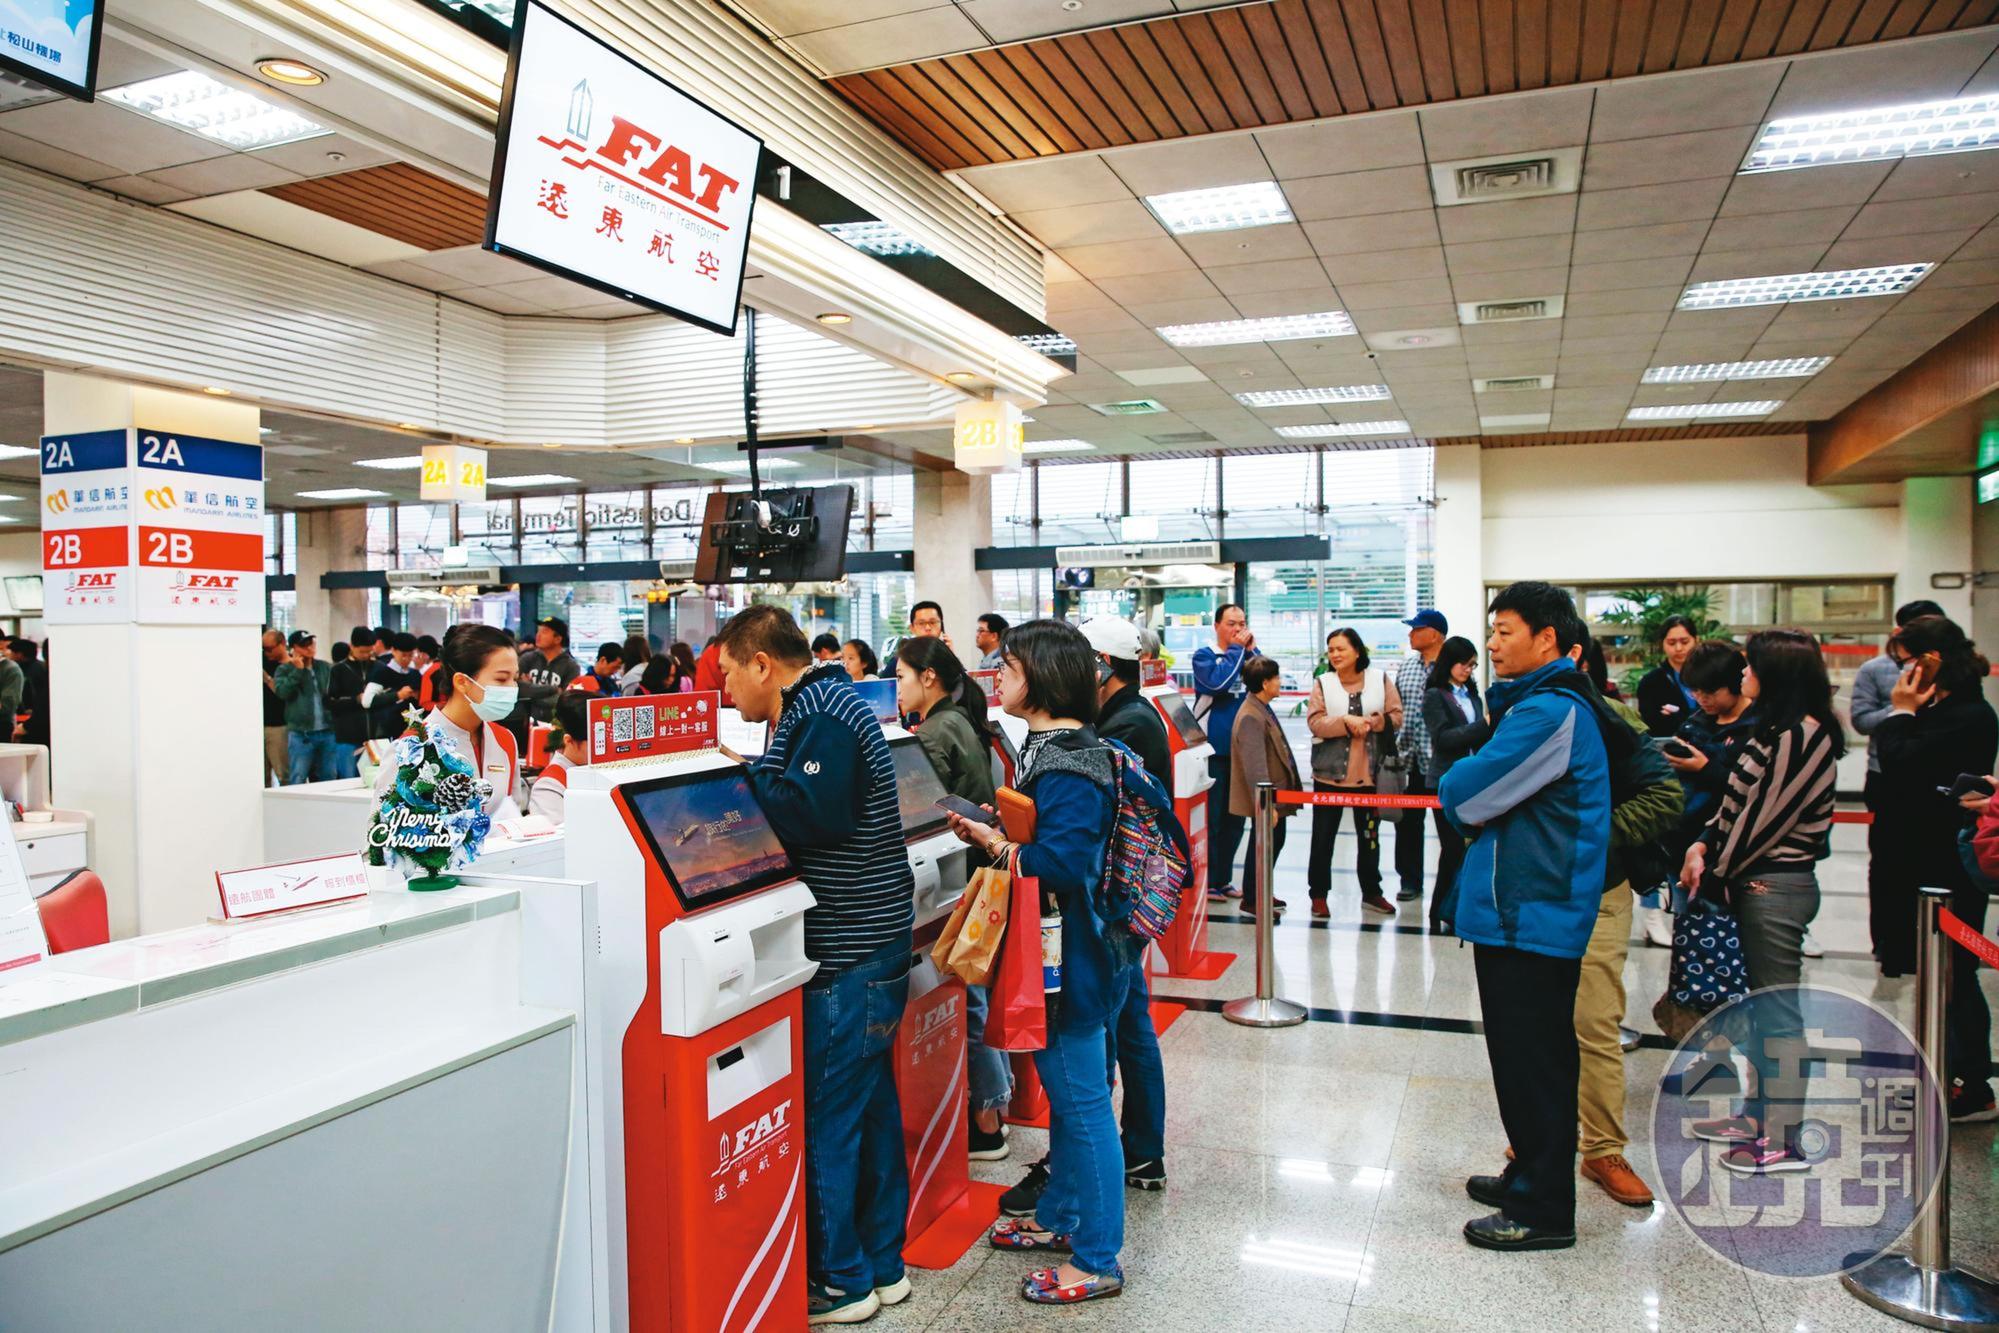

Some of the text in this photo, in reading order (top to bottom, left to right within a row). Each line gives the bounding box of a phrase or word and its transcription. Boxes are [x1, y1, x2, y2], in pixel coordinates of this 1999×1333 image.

[596, 115, 739, 213] FAT
[597, 175, 720, 244] Far Eastern Air Transport
[961, 418, 998, 448] 2B
[45, 441, 74, 468] 2A
[143, 436, 185, 466] 2A
[424, 460, 447, 483] 2A
[462, 463, 484, 486] 2A
[49, 534, 82, 565] 2B
[148, 532, 194, 564] 2B
[77, 573, 116, 586] FAT
[188, 575, 239, 588] FAT
[659, 706, 679, 721] LINE
[384, 808, 445, 833] Merry
[923, 993, 959, 1033] FAT
[732, 1098, 792, 1157] FAT
